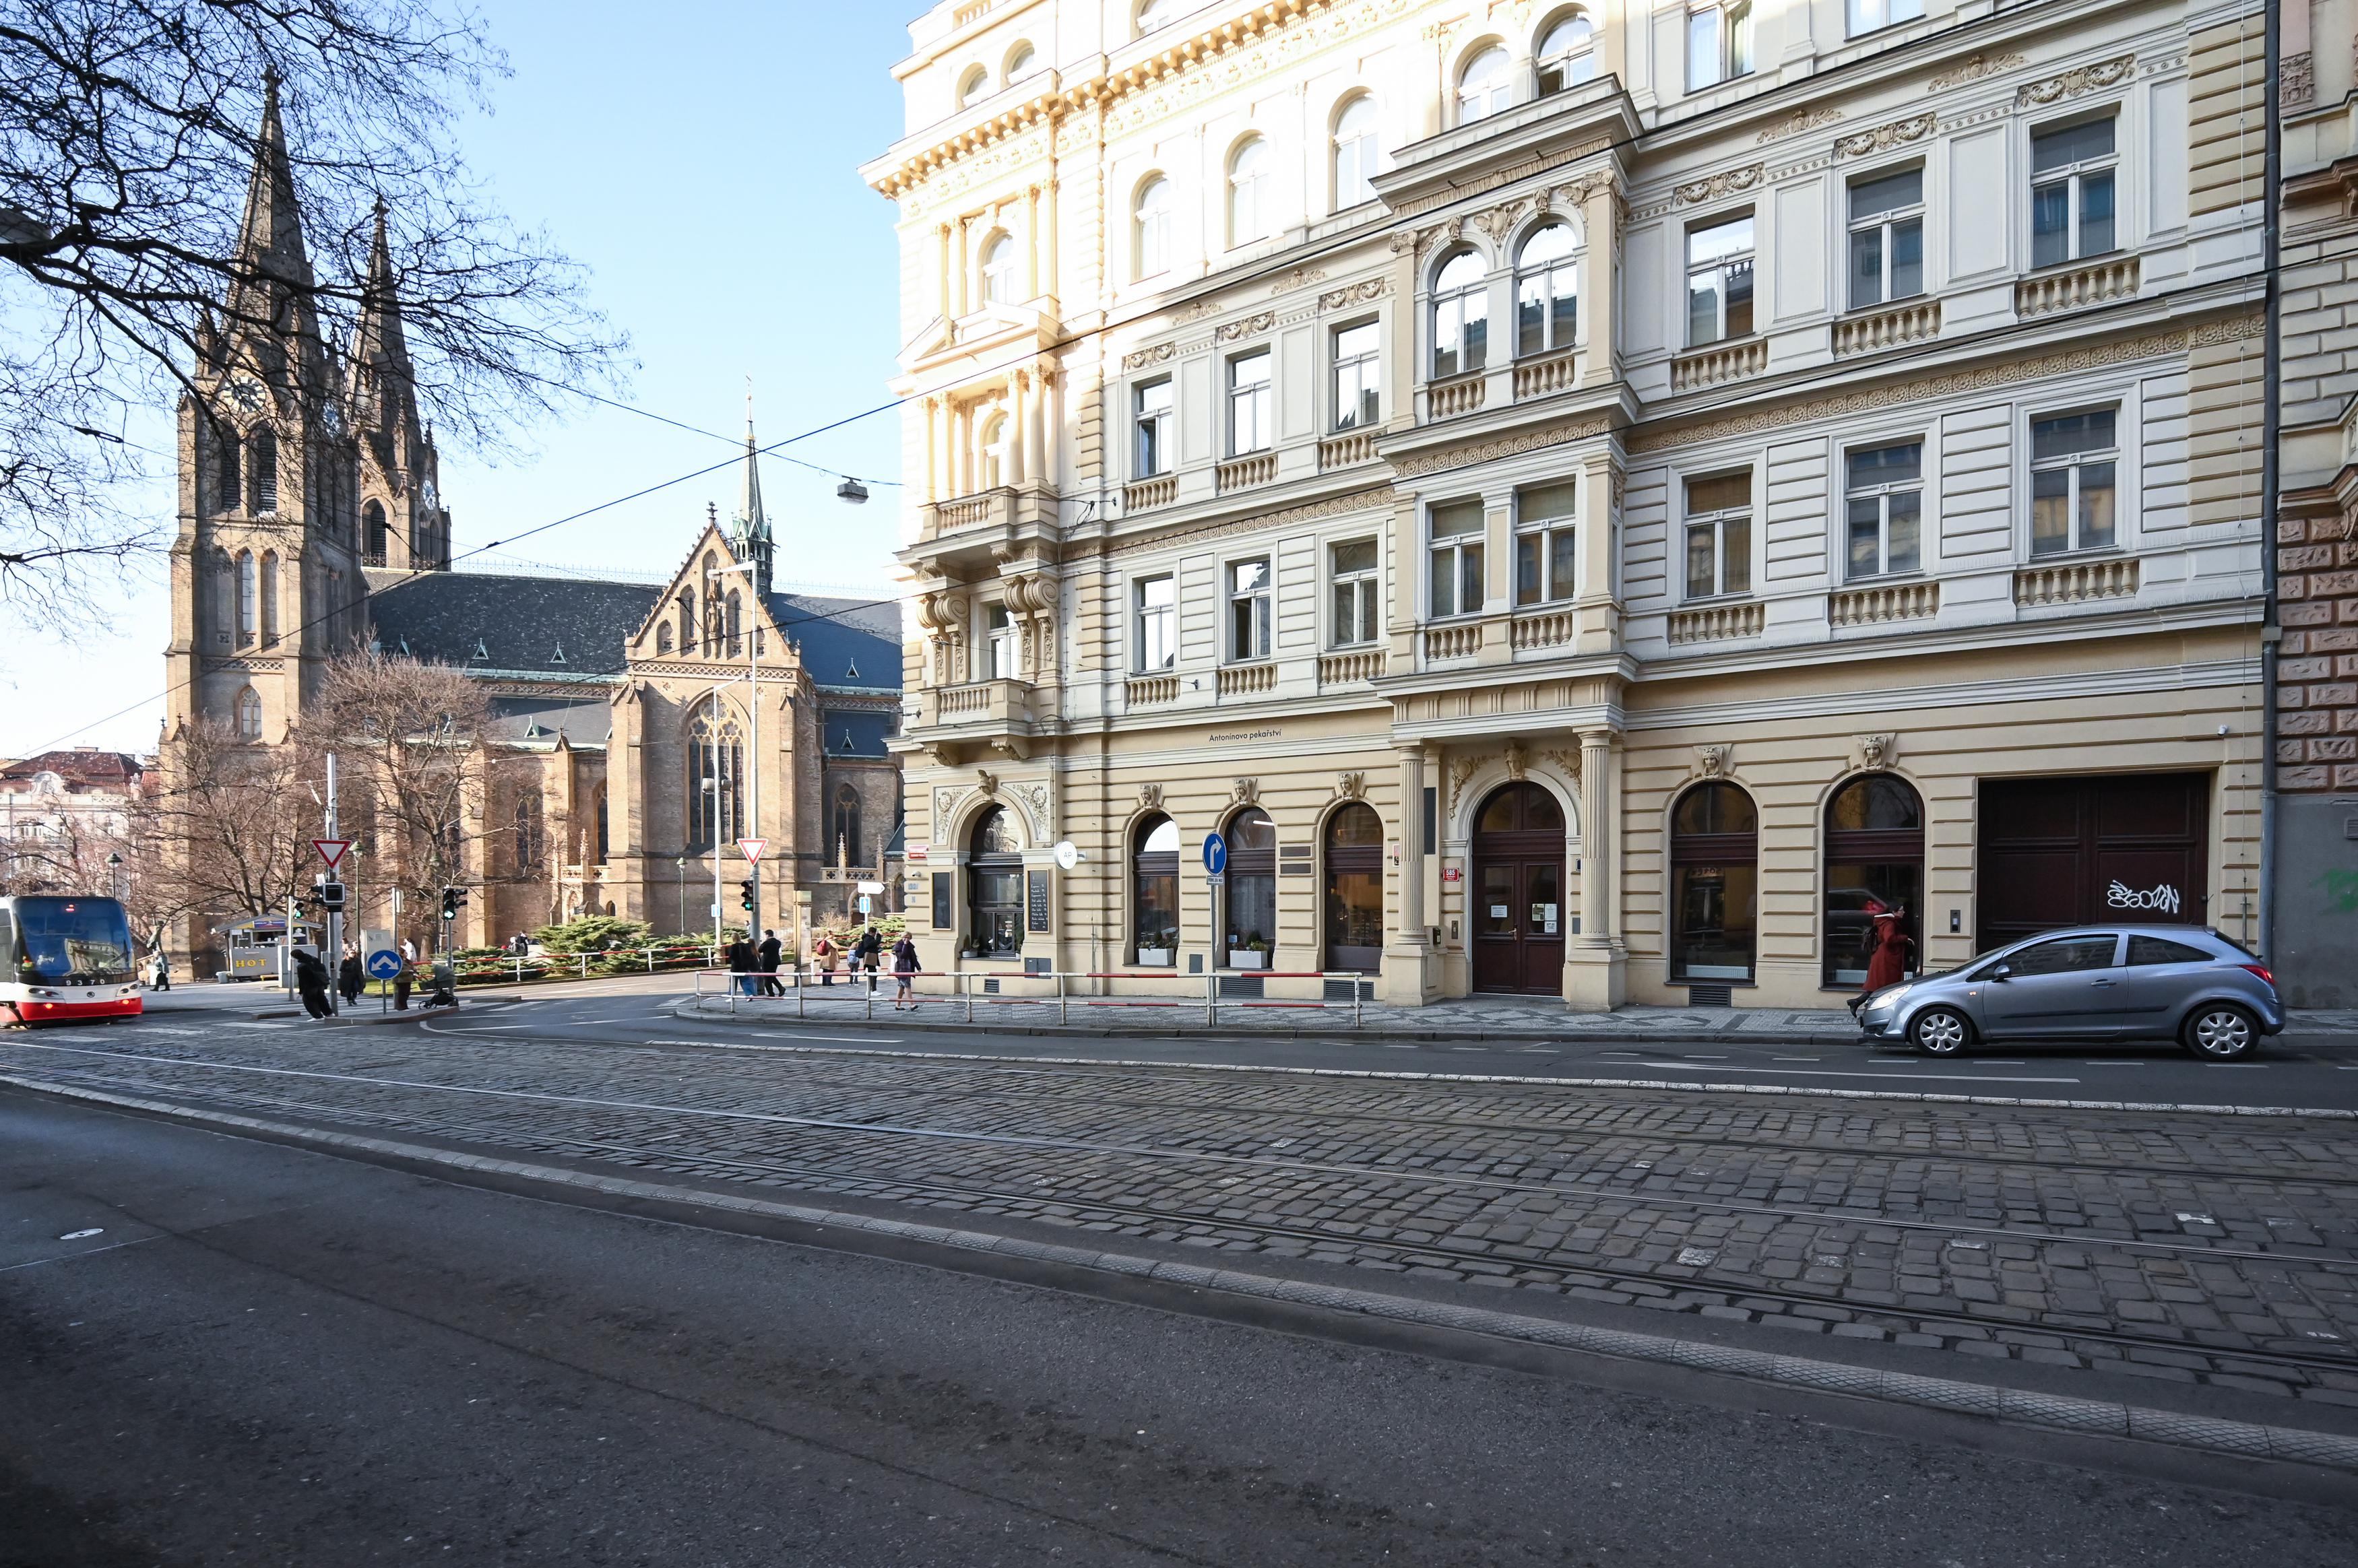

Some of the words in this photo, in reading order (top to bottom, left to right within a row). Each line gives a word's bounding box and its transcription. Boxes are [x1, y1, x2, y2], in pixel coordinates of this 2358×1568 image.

[1209, 733, 1248, 742] Antonínovo
[1249, 729, 1281, 740] pekařství
[236, 958, 266, 967] HOT
